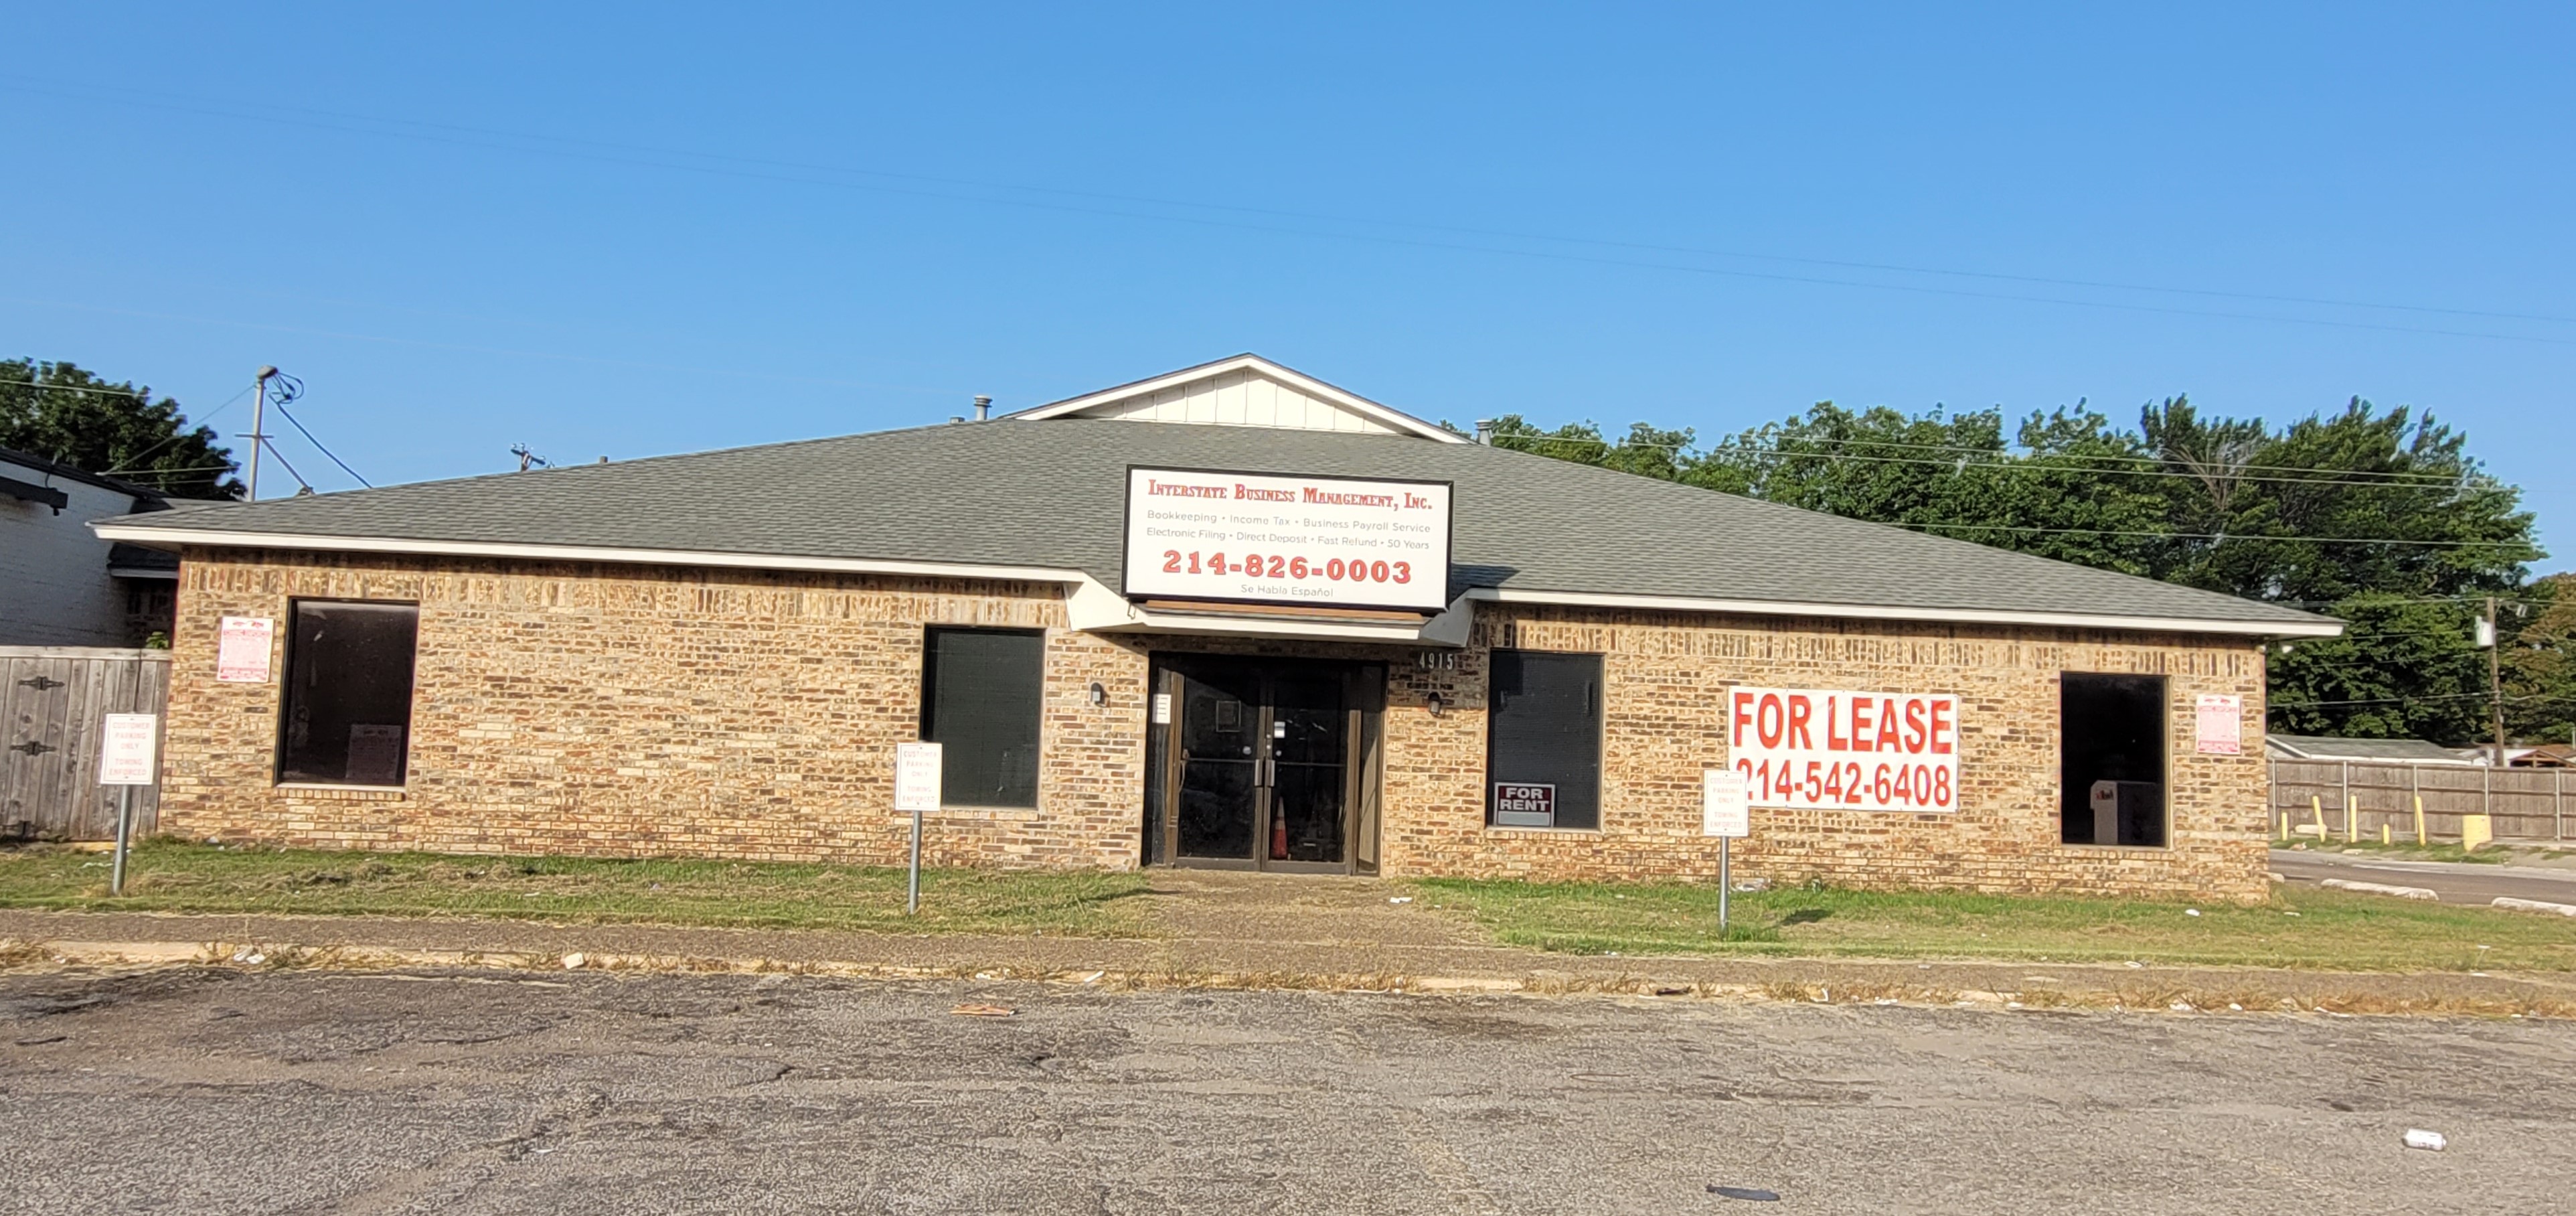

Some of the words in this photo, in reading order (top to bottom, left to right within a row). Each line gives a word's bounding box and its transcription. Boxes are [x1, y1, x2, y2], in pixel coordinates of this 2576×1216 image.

[1147, 510, 1217, 524] Bookkeeping
[1230, 514, 1269, 525] Income
[1273, 516, 1290, 526] Tax
[1303, 518, 1349, 528] Business
[1353, 521, 1388, 531] Payroll
[1392, 523, 1431, 533] Service
[1147, 527, 1196, 538] Electronic
[1199, 530, 1226, 541] Filing
[1236, 532, 1266, 542] Direct
[1269, 534, 1307, 544] Deposit
[1318, 536, 1338, 545] Fast
[1342, 537, 1377, 547] Refund
[1387, 540, 1400, 548] 50
[1404, 540, 1429, 550] Years
[1163, 550, 1411, 584] 214-826-0003
[1241, 585, 1254, 593] Se
[1258, 585, 1287, 595] Habla
[1292, 587, 1334, 598] Español
[1419, 651, 1453, 670] 4915
[1734, 692, 1813, 750] FOR
[1828, 696, 1952, 754] LEASE
[1506, 787, 1543, 799] FOR
[1500, 799, 1549, 811] RENT
